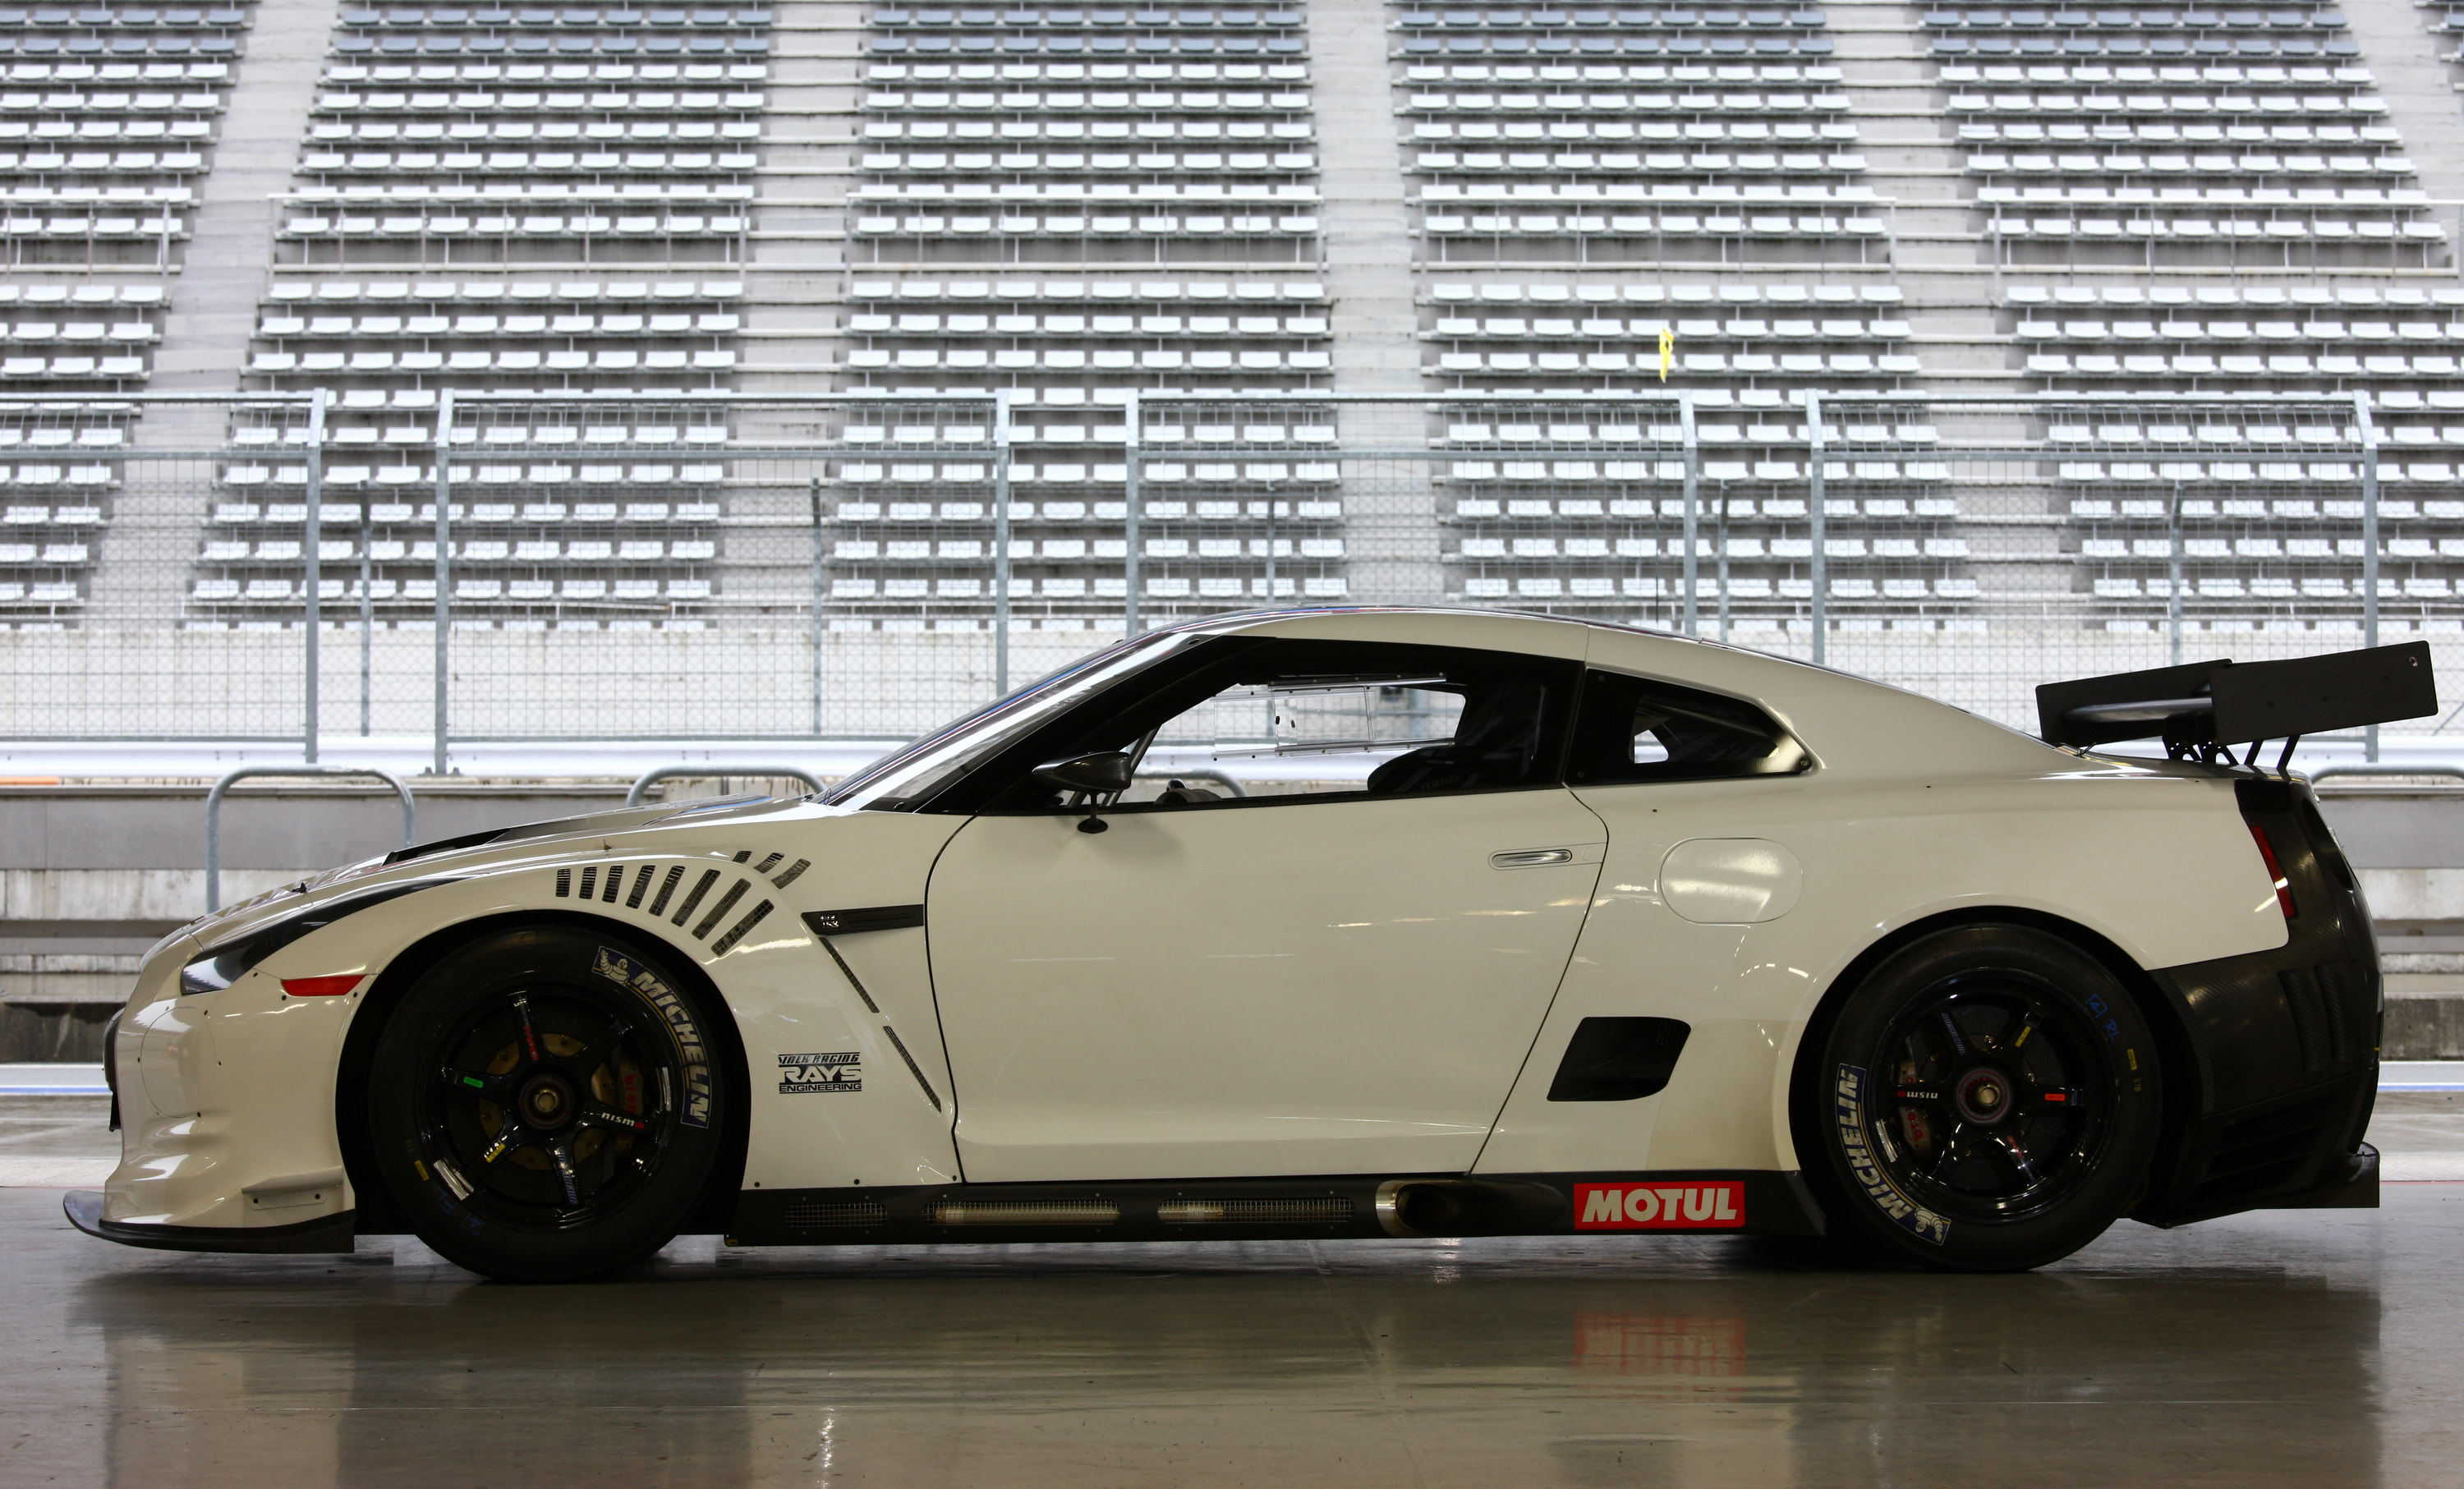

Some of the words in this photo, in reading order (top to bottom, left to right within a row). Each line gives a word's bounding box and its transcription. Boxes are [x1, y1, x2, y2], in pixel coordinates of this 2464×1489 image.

[632, 971, 710, 1123] MICHELIN
[812, 1054, 860, 1064] RACING
[779, 1065, 862, 1083] RAYS
[779, 1083, 862, 1092] ENGINEERING
[1837, 1068, 1914, 1220] MICHELIN
[1581, 1188, 1738, 1222] MOTUL
